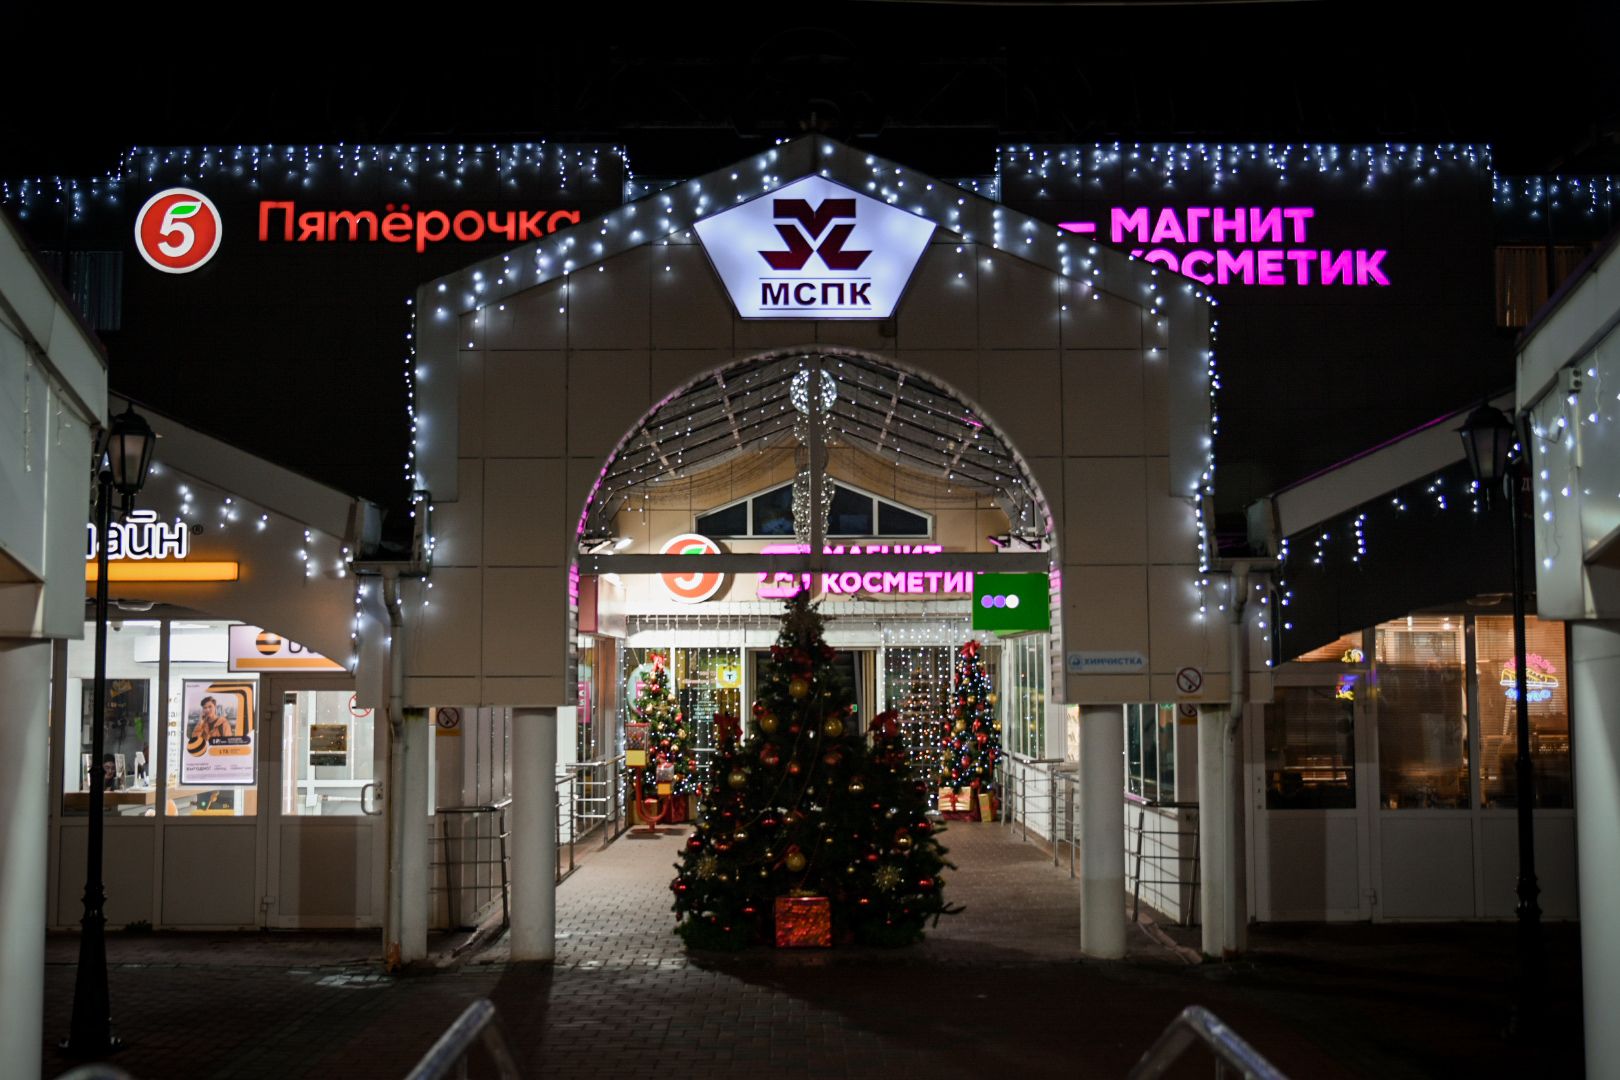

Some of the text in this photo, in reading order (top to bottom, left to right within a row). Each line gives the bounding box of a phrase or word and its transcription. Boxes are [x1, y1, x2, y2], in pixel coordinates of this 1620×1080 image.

[1110, 207, 1315, 243] МАГНИТ
[761, 282, 871, 306] МСПК
[1084, 656, 1143, 666] ХИМЧИСТКА
